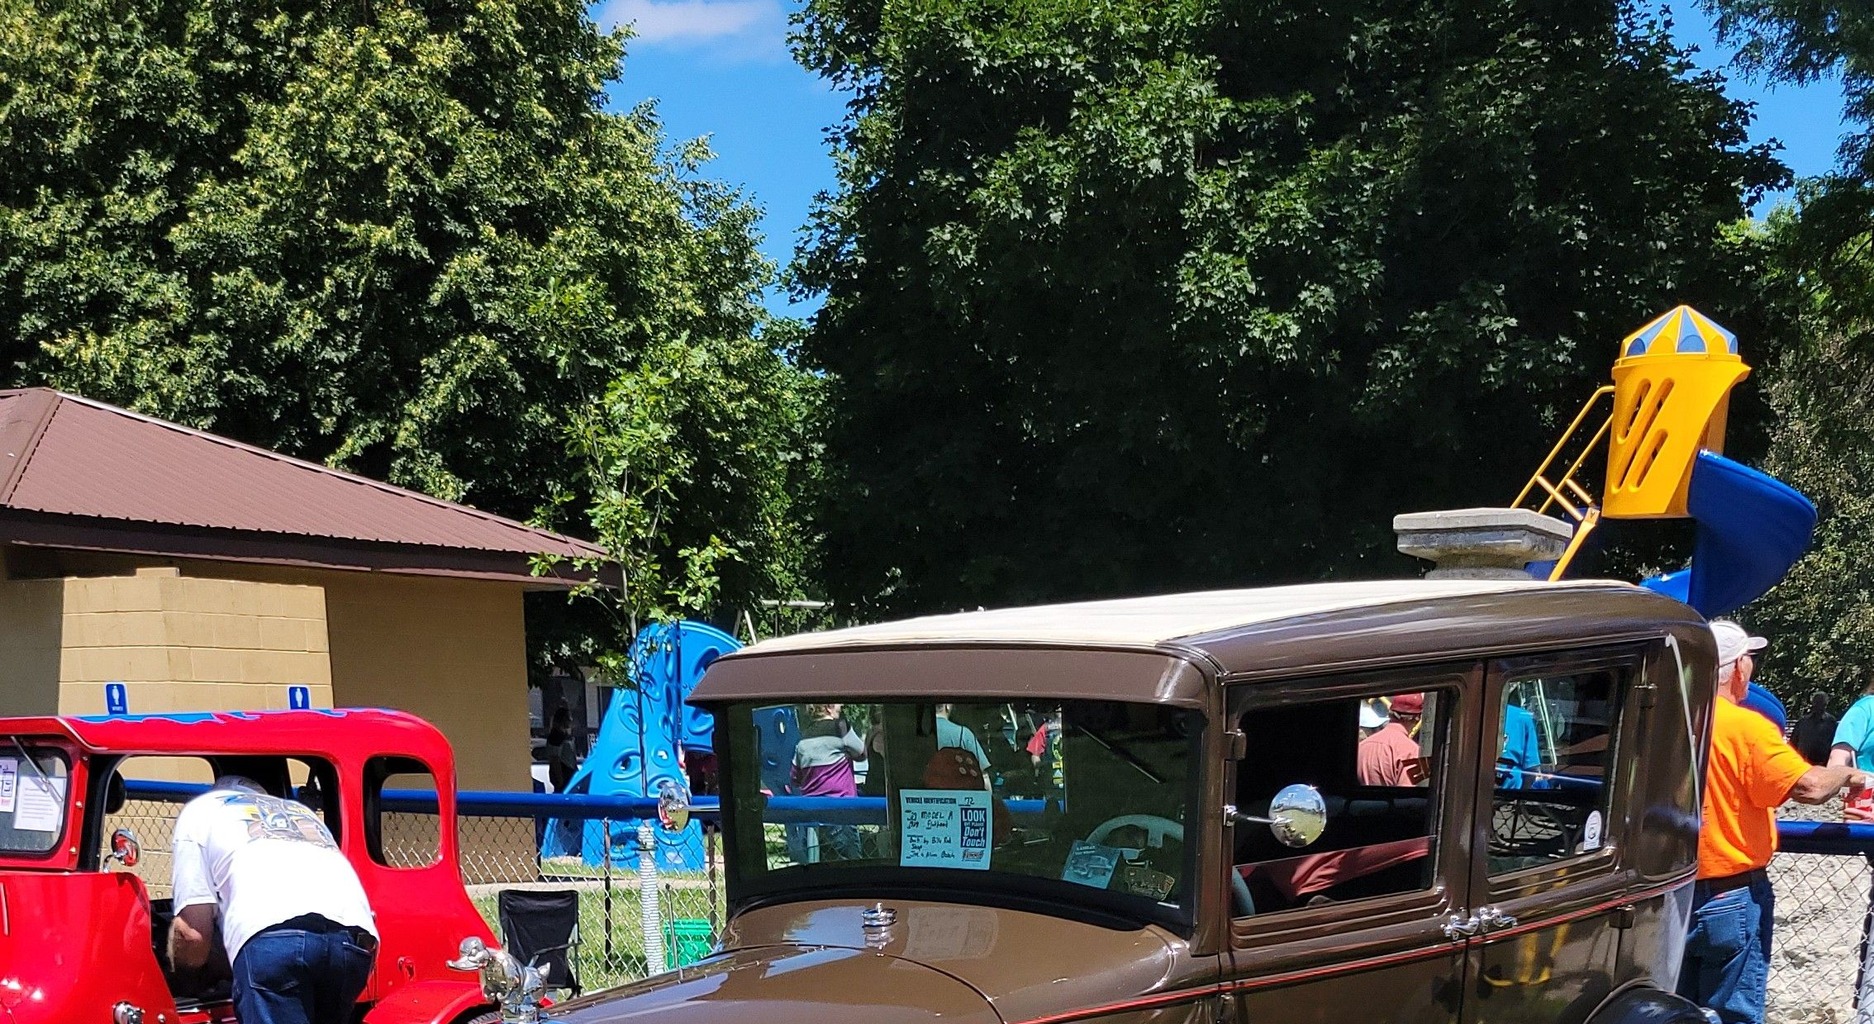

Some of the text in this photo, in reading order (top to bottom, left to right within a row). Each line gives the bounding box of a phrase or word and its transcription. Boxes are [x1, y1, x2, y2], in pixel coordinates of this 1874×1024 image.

[962, 809, 985, 822] LOOK
[964, 827, 984, 838] Don't
[962, 836, 985, 848] Touch
